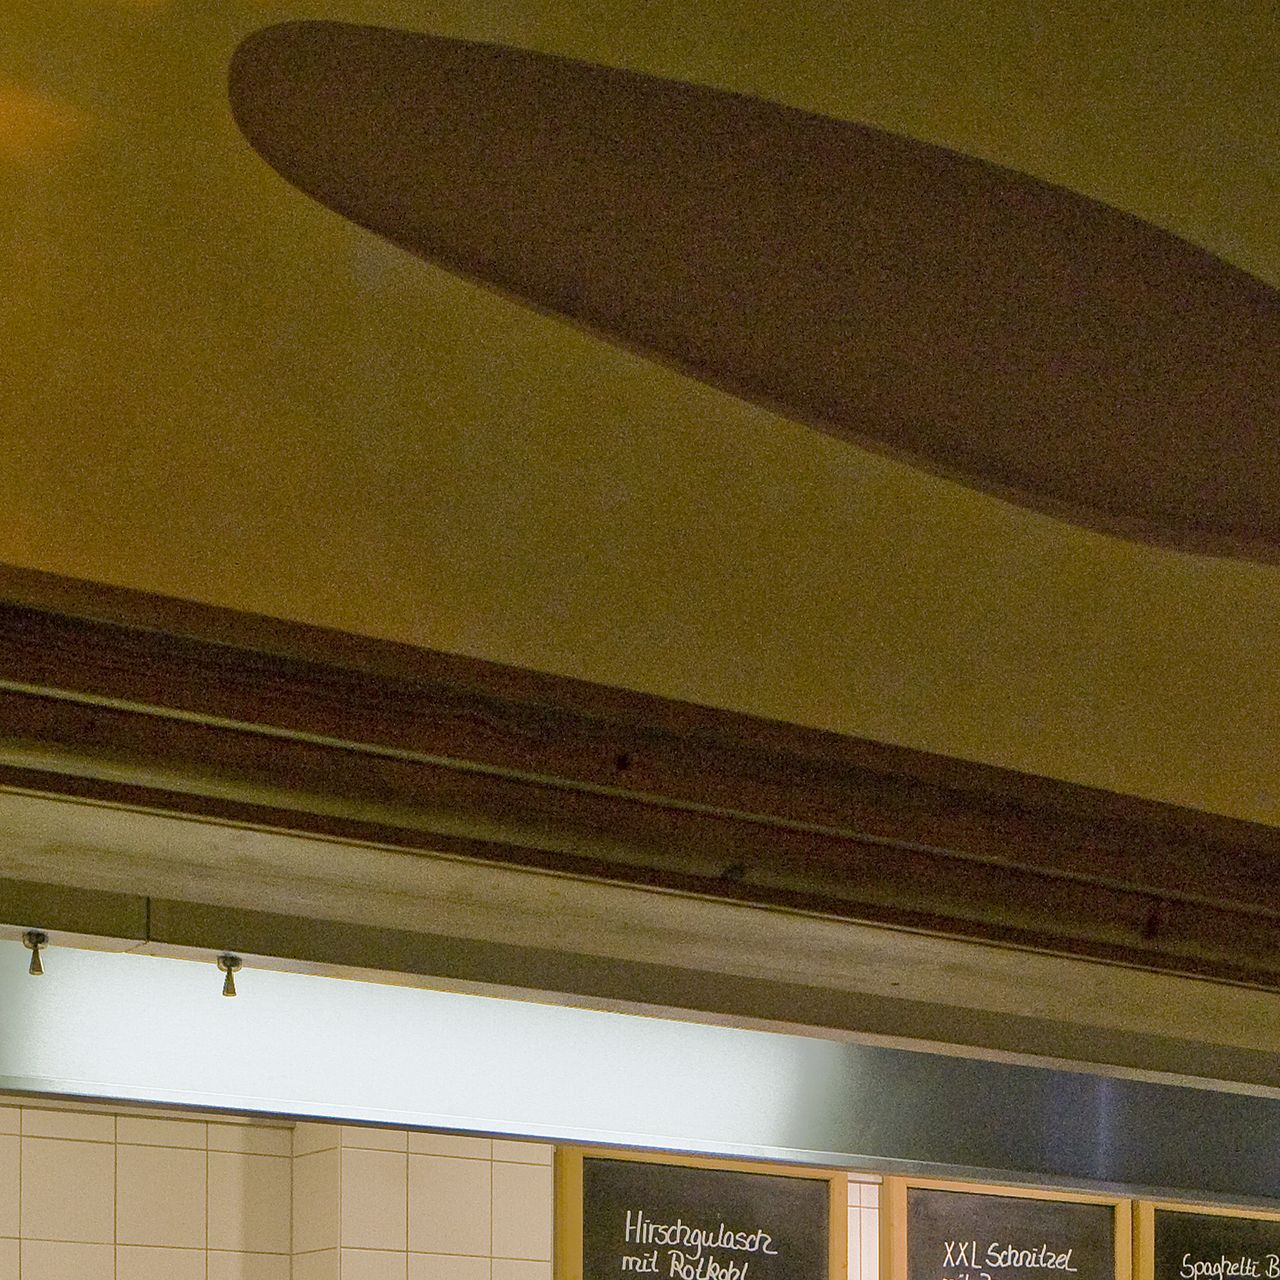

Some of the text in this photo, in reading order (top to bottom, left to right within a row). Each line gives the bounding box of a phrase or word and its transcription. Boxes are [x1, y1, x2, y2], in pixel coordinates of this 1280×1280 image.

[625, 1210, 778, 1260] Hirschgulasch
[621, 1250, 659, 1273] mit
[943, 1240, 1077, 1272] XXL Schnitzel
